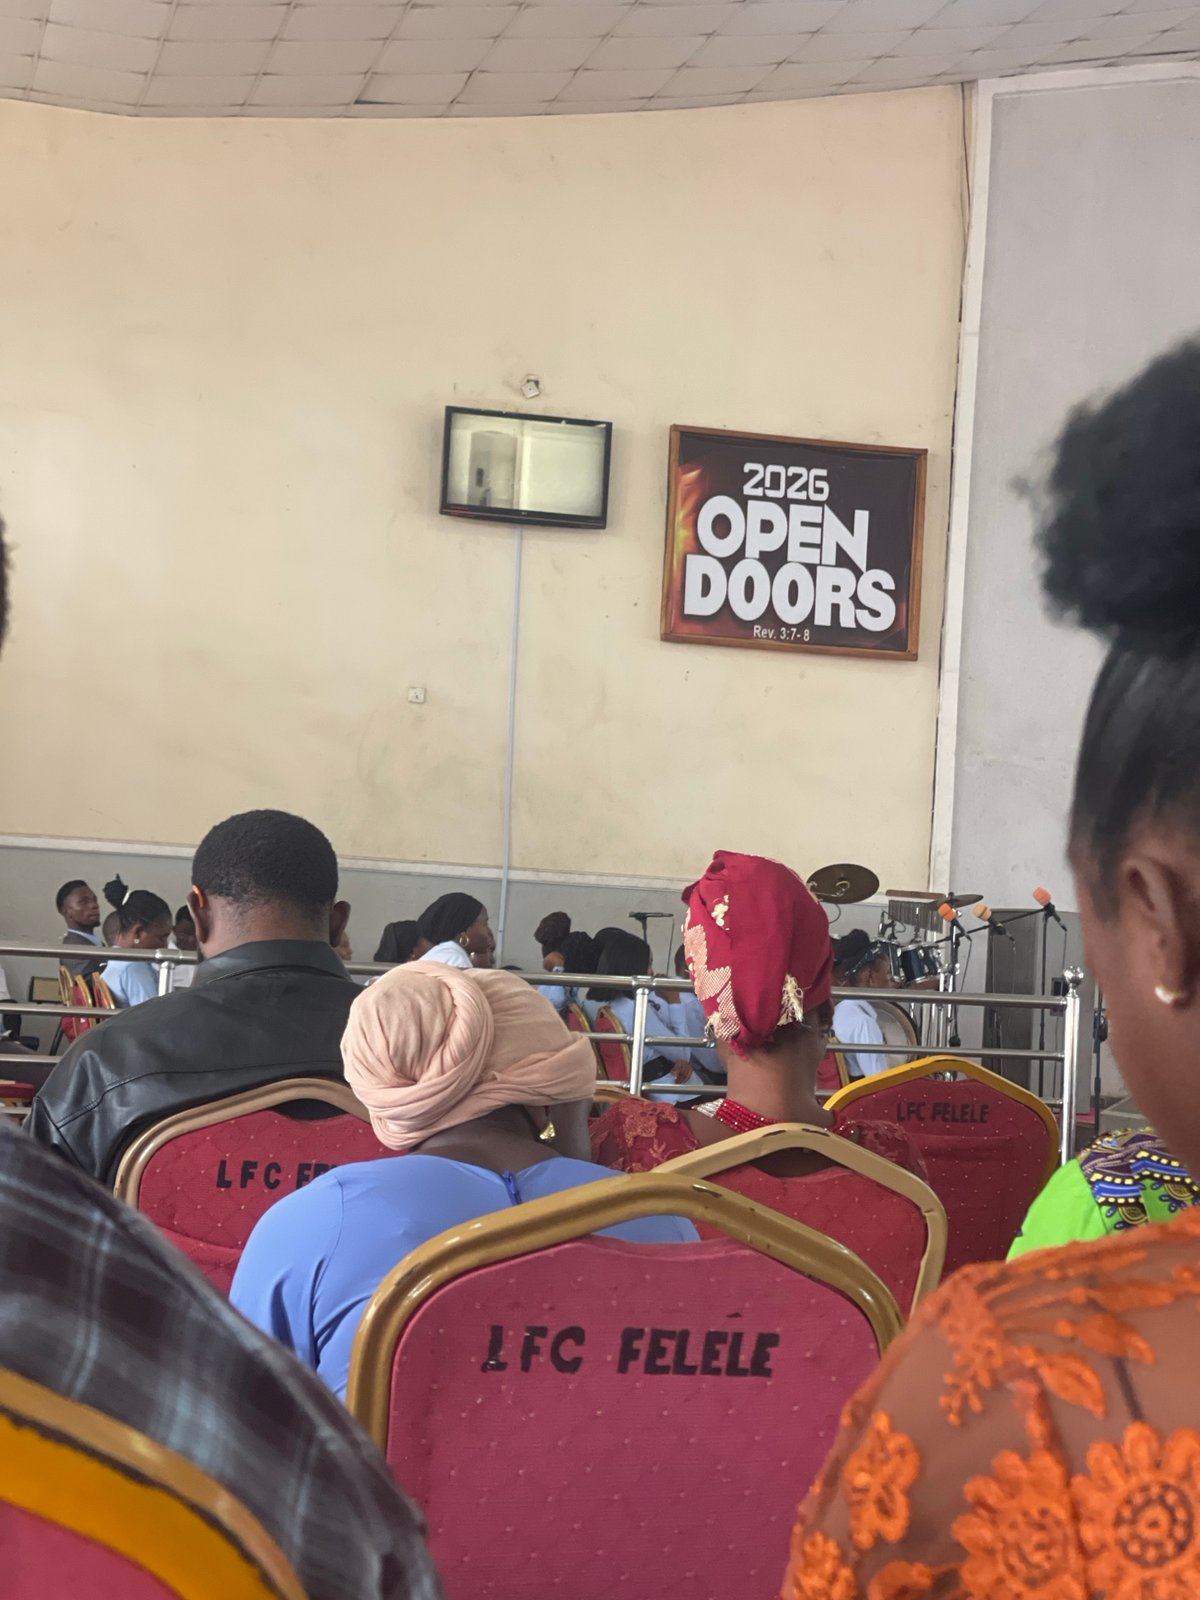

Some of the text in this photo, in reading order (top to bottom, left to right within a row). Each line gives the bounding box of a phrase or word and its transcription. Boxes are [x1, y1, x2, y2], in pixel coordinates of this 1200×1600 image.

[743, 462, 830, 501] 2026
[697, 495, 869, 573] OPEN
[684, 554, 896, 632] DOORS
[753, 624, 777, 640] Rev.
[896, 1101, 990, 1124] LFC FELELE
[216, 1159, 282, 1190] LFC
[480, 1324, 781, 1378] LFC FELELE
